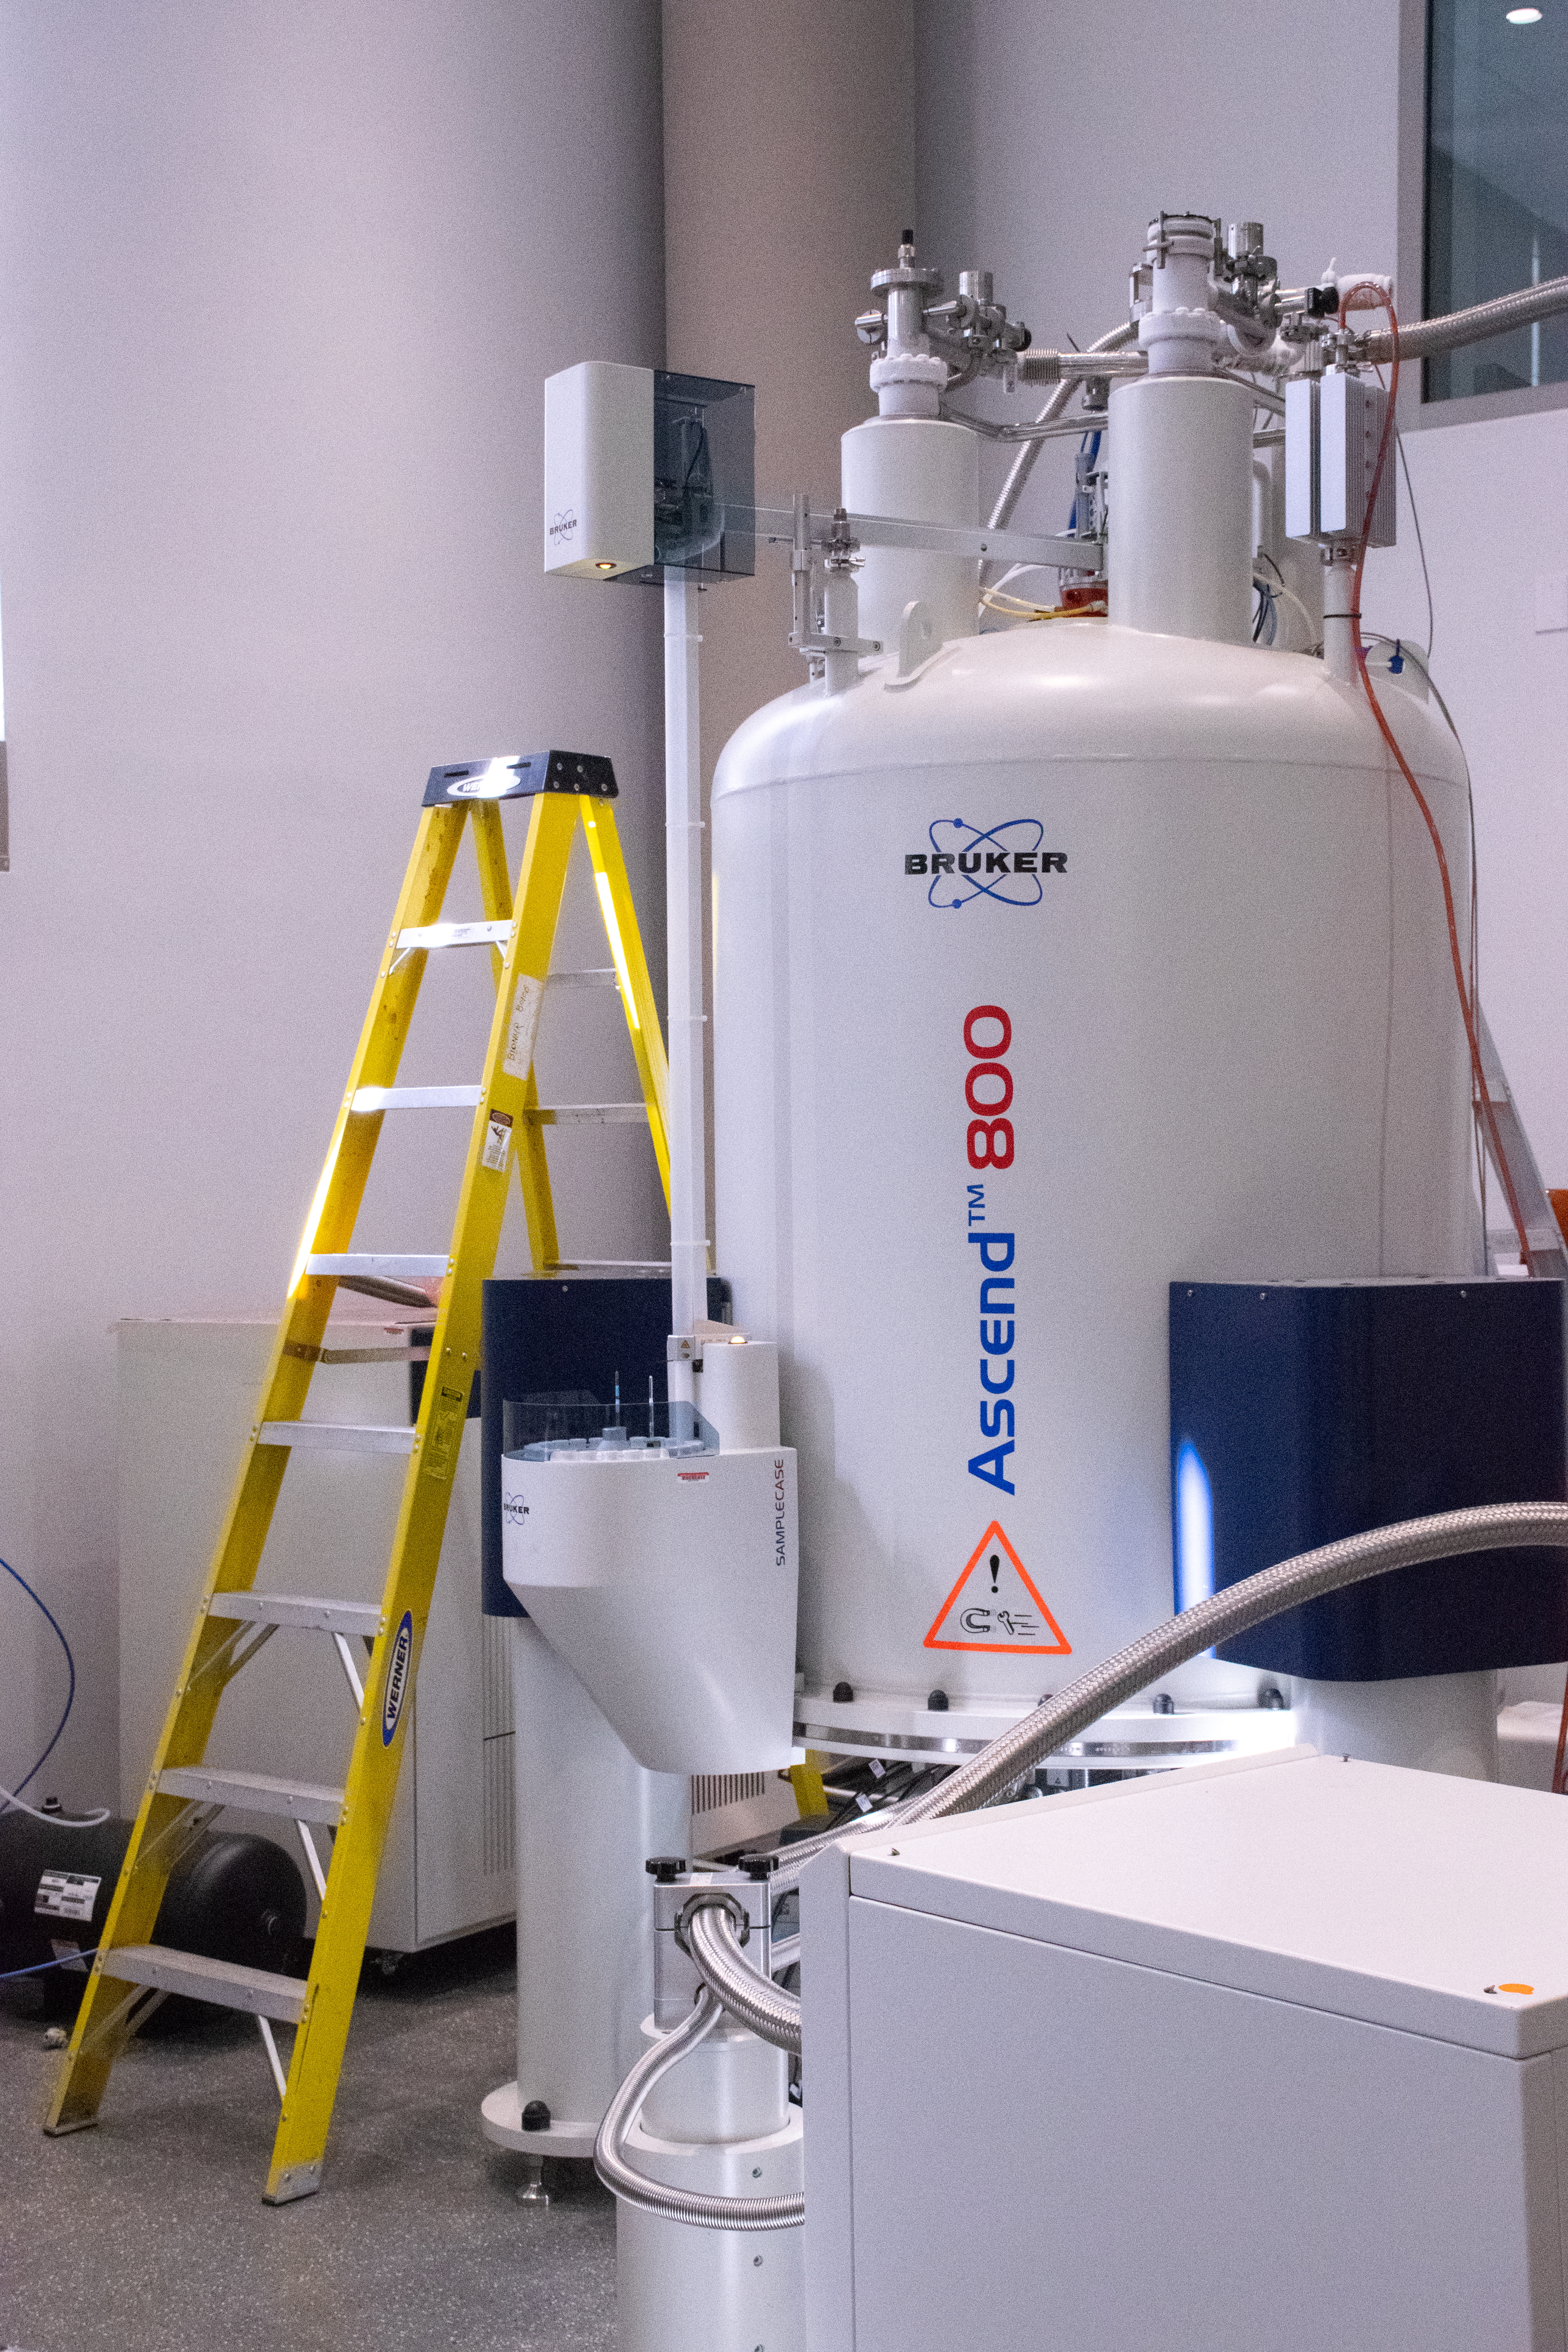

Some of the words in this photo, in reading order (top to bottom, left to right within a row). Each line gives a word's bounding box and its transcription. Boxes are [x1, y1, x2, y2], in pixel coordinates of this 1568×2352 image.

[549, 519, 577, 535] BRUKER
[904, 852, 1068, 875] BRUKER
[963, 1005, 1015, 1169] 800
[503, 1503, 529, 1515] BRUKER
[774, 1459, 786, 1566] SAMPLECASE
[387, 1636, 408, 1718] WERNER
